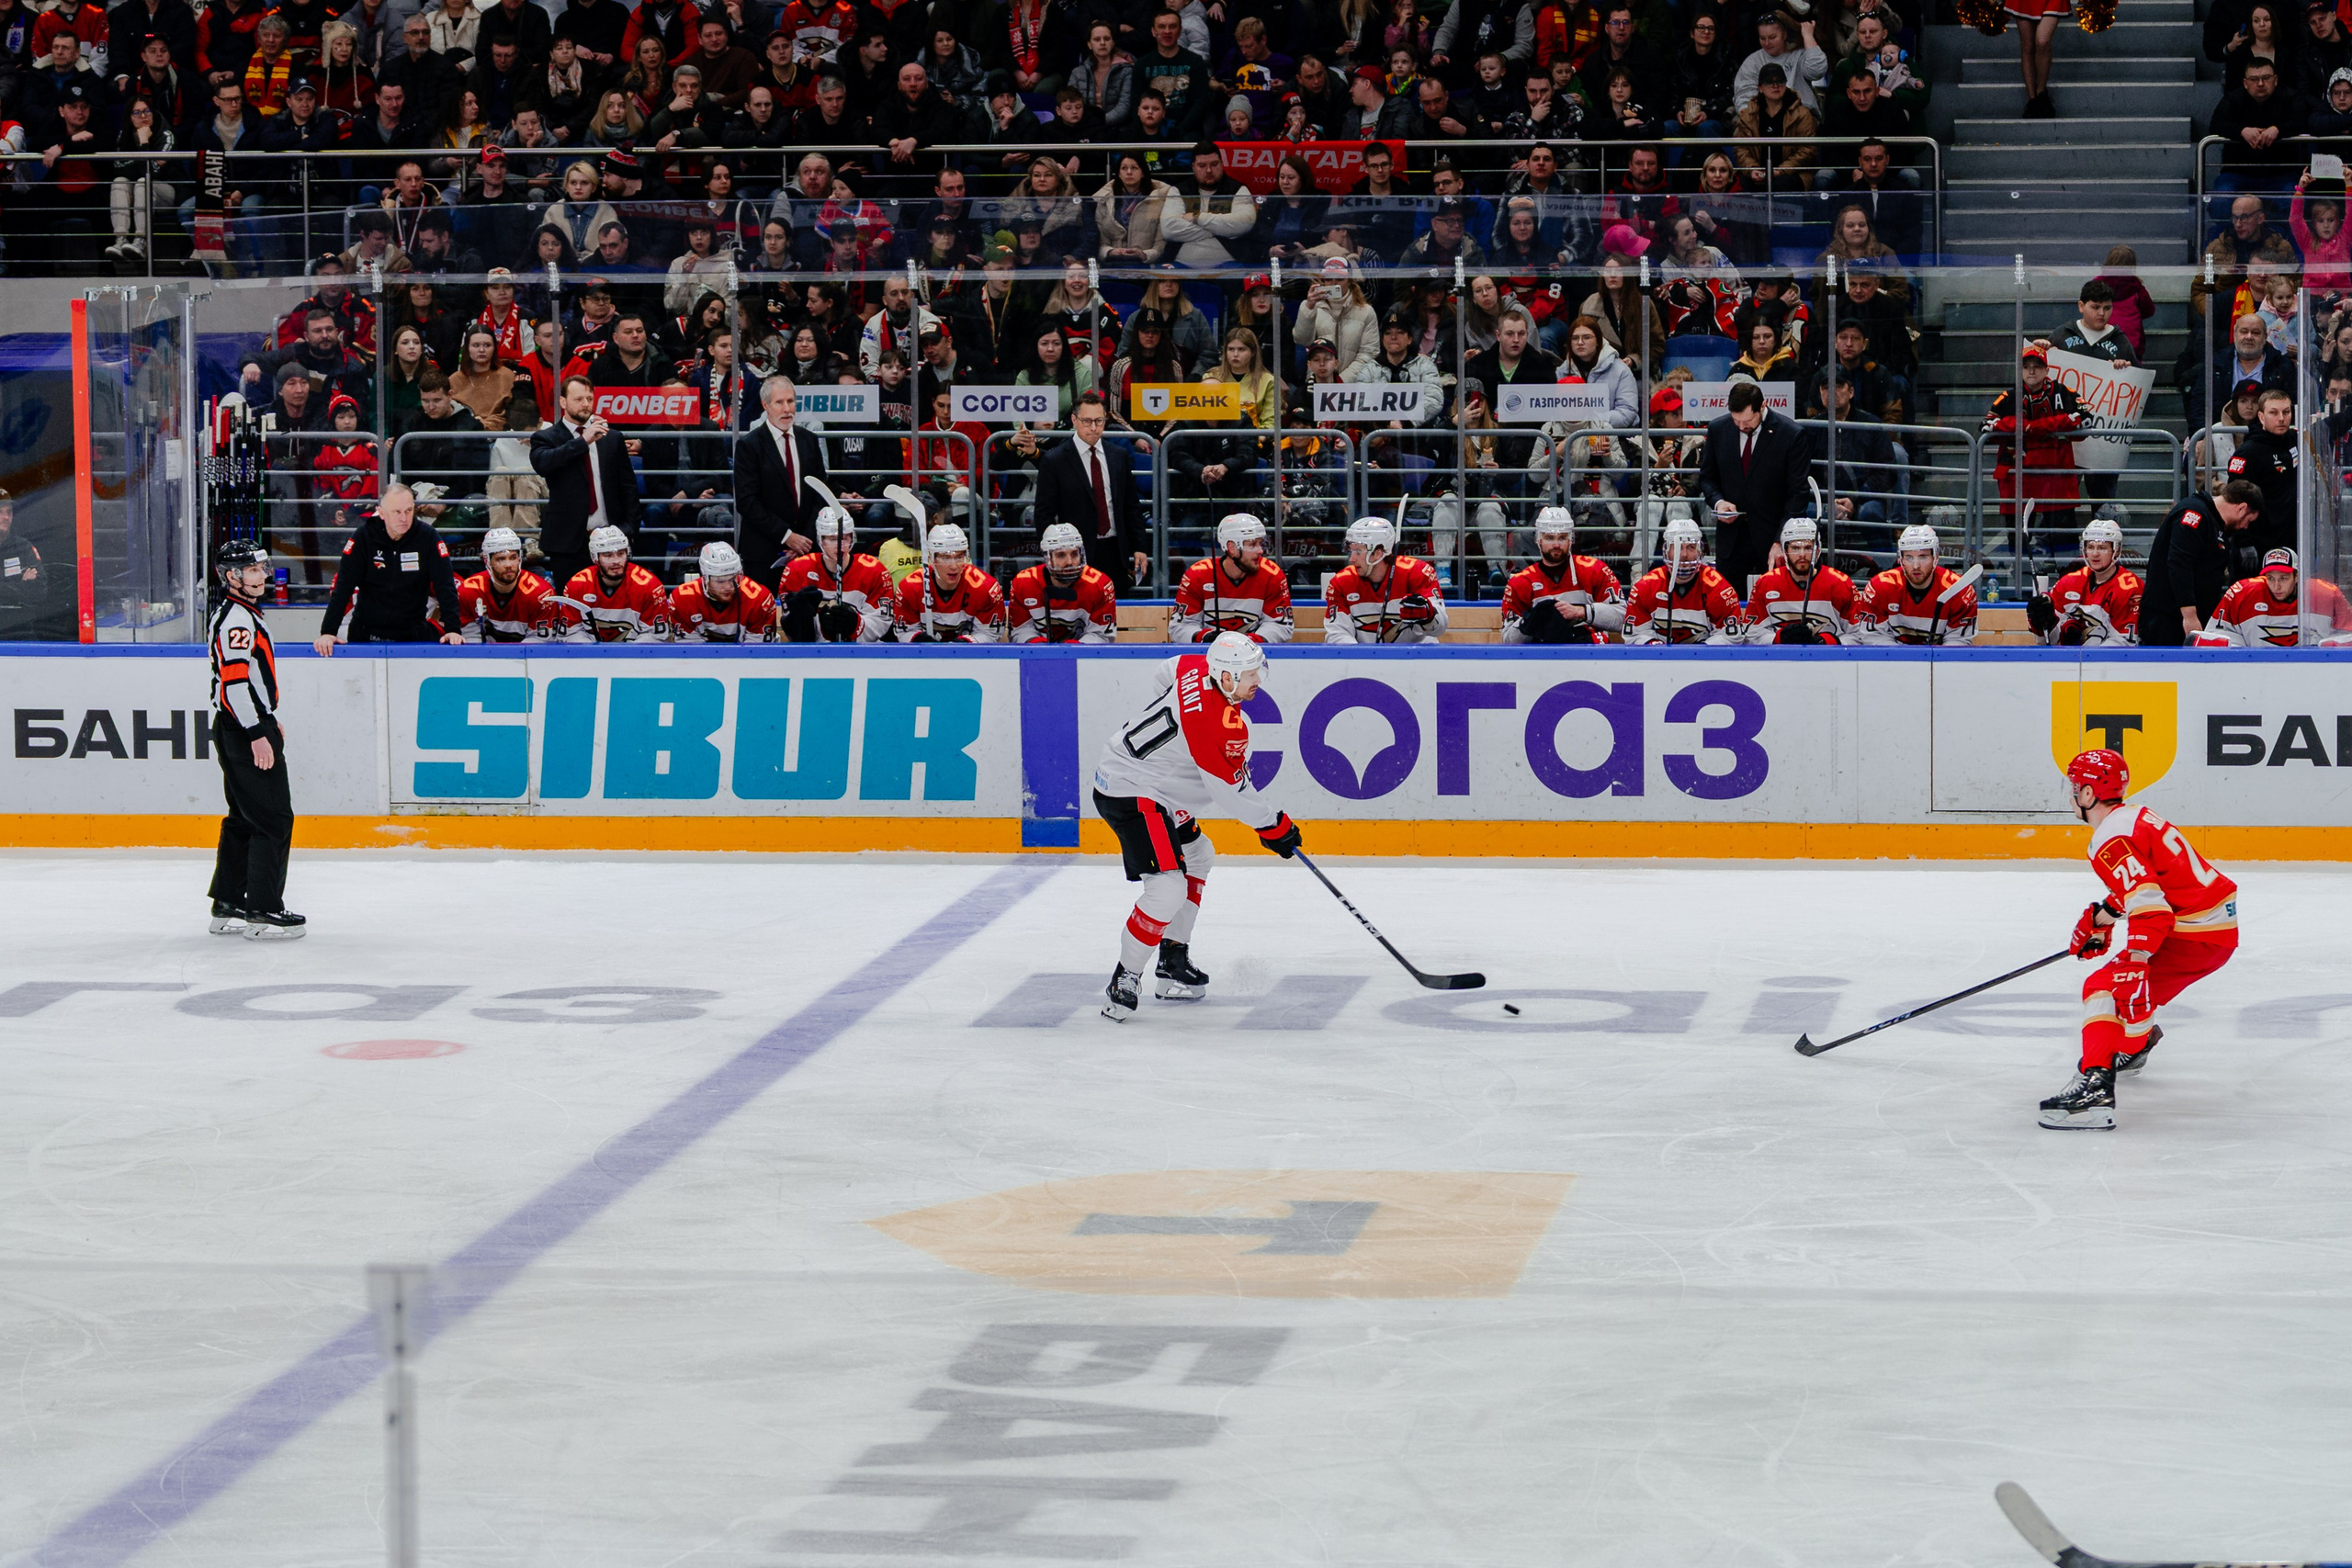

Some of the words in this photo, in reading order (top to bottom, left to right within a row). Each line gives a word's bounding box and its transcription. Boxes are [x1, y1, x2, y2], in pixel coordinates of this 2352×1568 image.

[1223, 148, 1367, 172] АВАНГАР
[594, 395, 698, 416] FONBET
[1174, 395, 1228, 408] БАНК
[1319, 391, 1419, 412] KHL.RU
[1529, 396, 1605, 409] ГАЗПРОМБАНК
[230, 629, 251, 649] 22
[1181, 667, 1204, 714] GRANT
[413, 677, 983, 801] SIBUR
[2112, 855, 2148, 891] 24
[1338, 895, 1382, 937] CCM
[2112, 970, 2145, 983] CM
